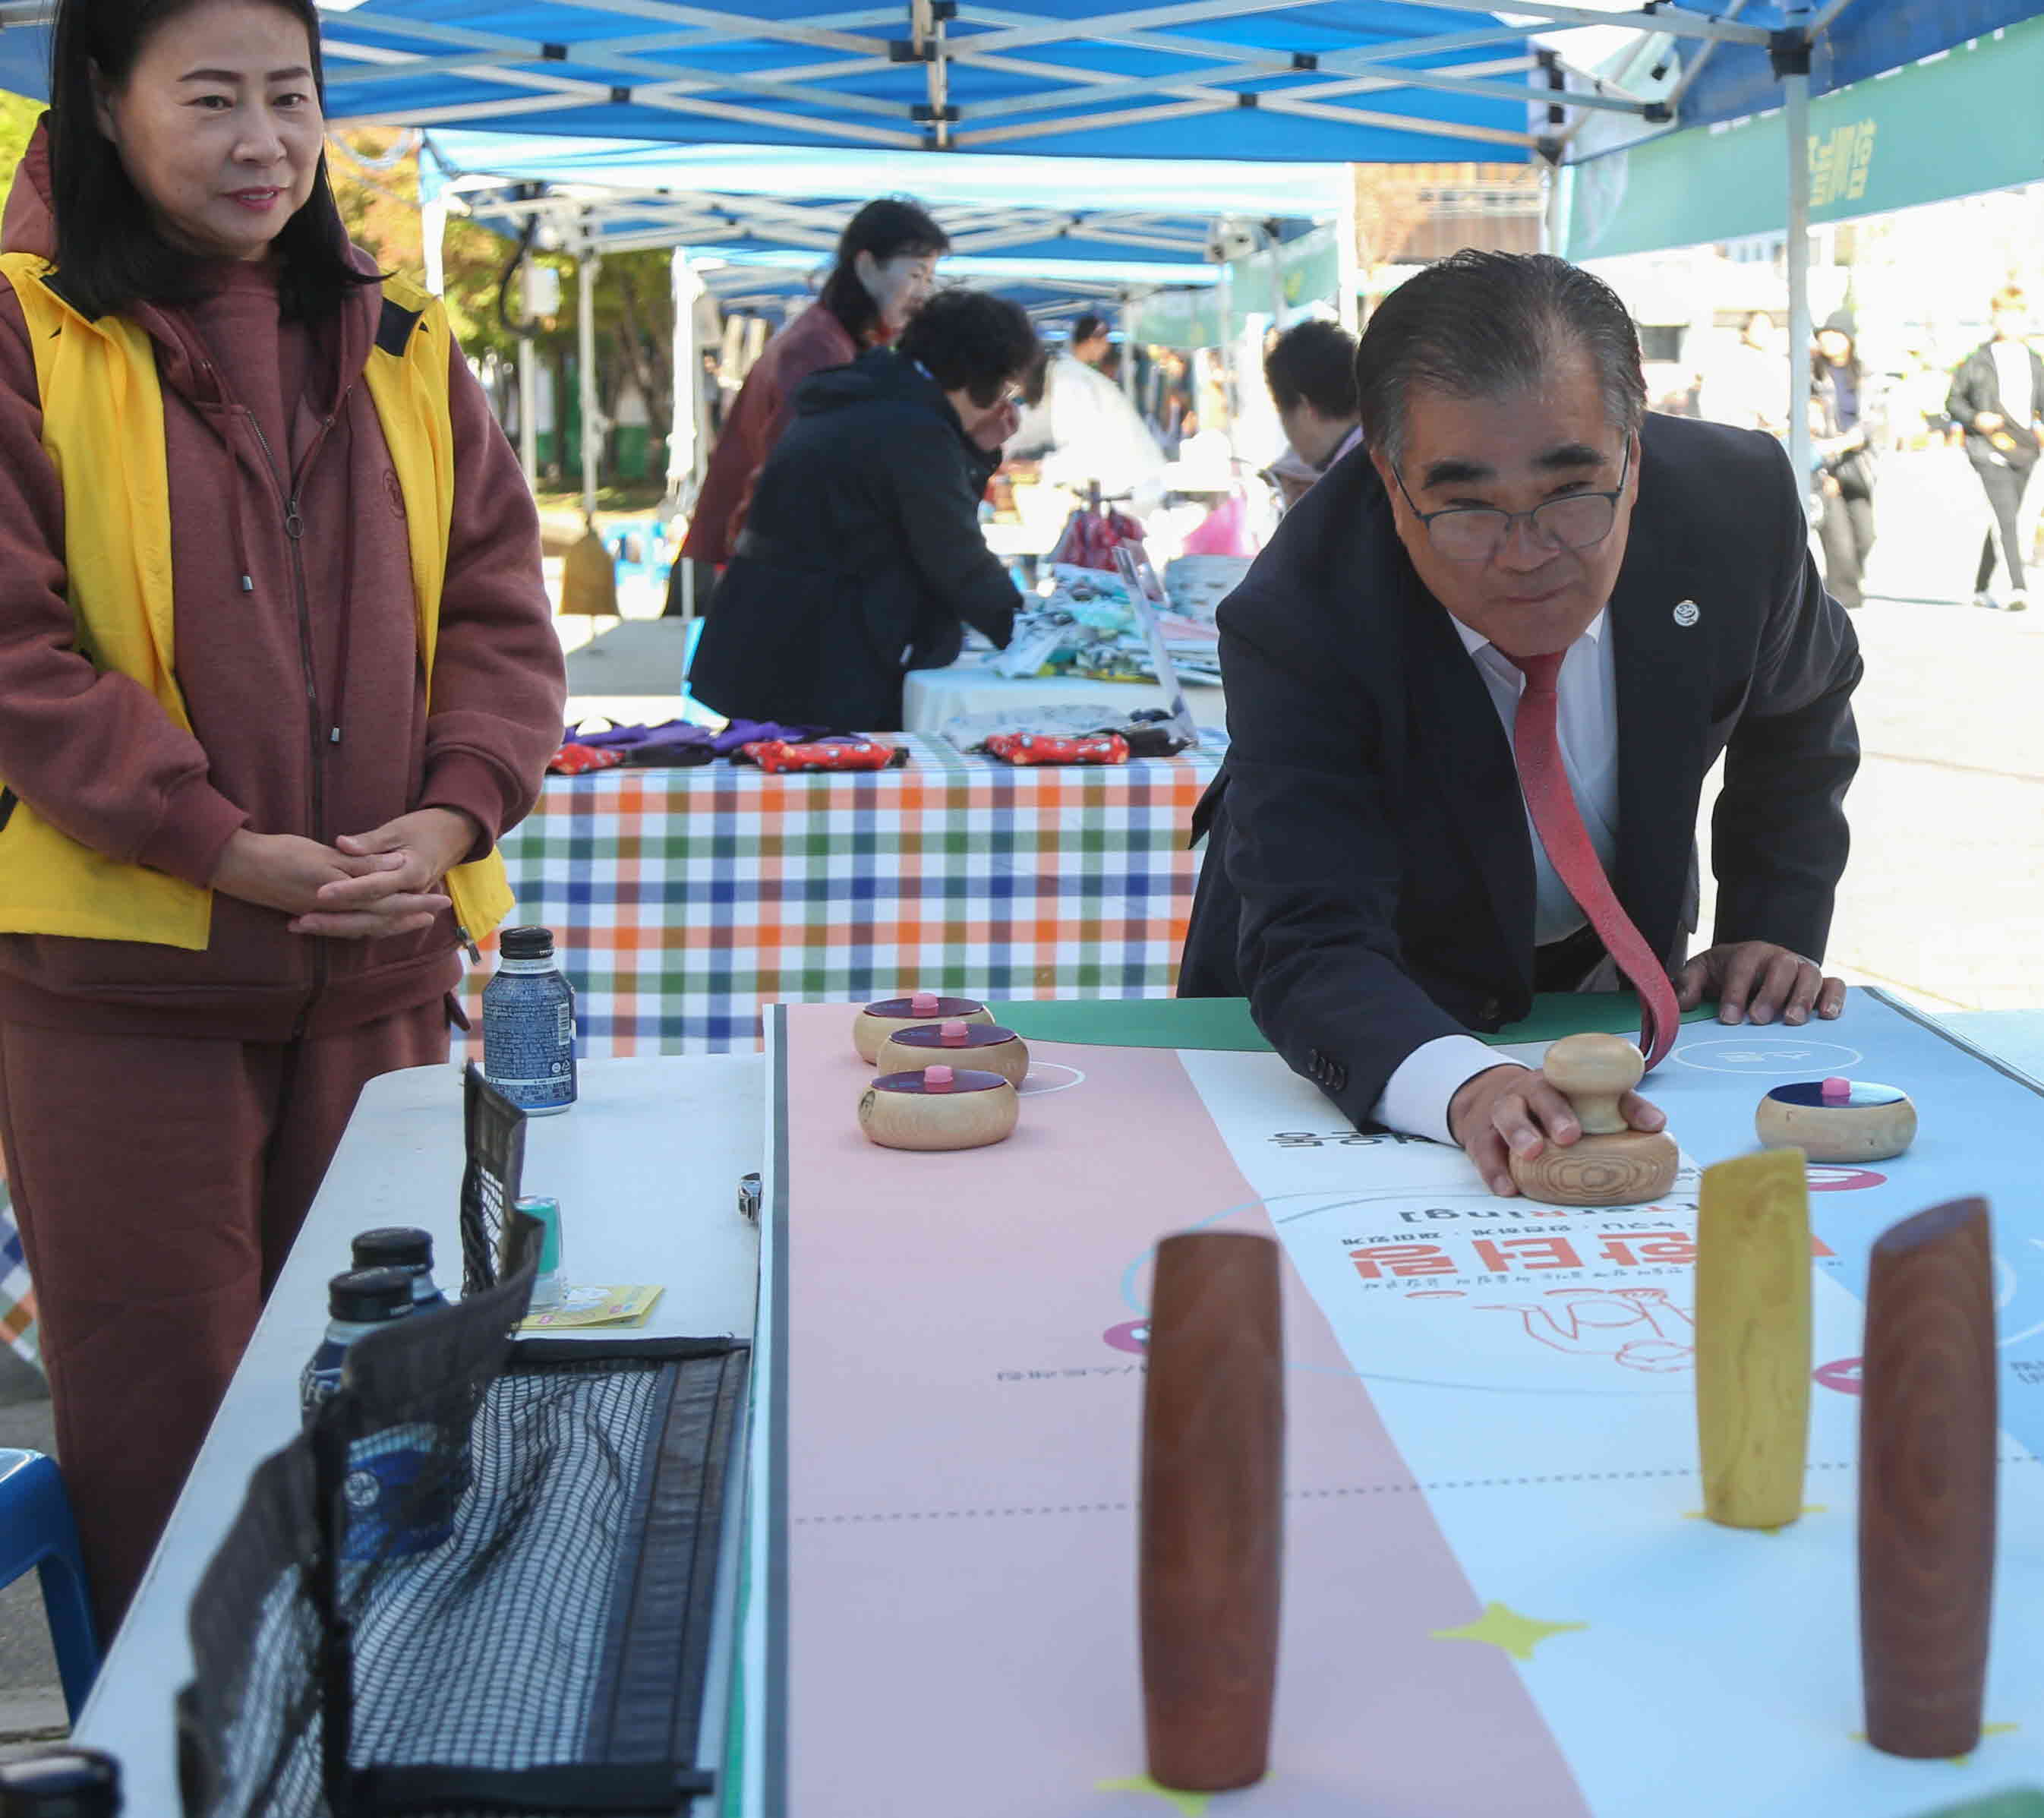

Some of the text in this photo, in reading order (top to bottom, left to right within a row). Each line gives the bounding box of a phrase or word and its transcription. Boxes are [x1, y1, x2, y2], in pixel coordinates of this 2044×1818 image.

[1341, 1220, 1676, 1246] 누구나 안전하게 재미있게
